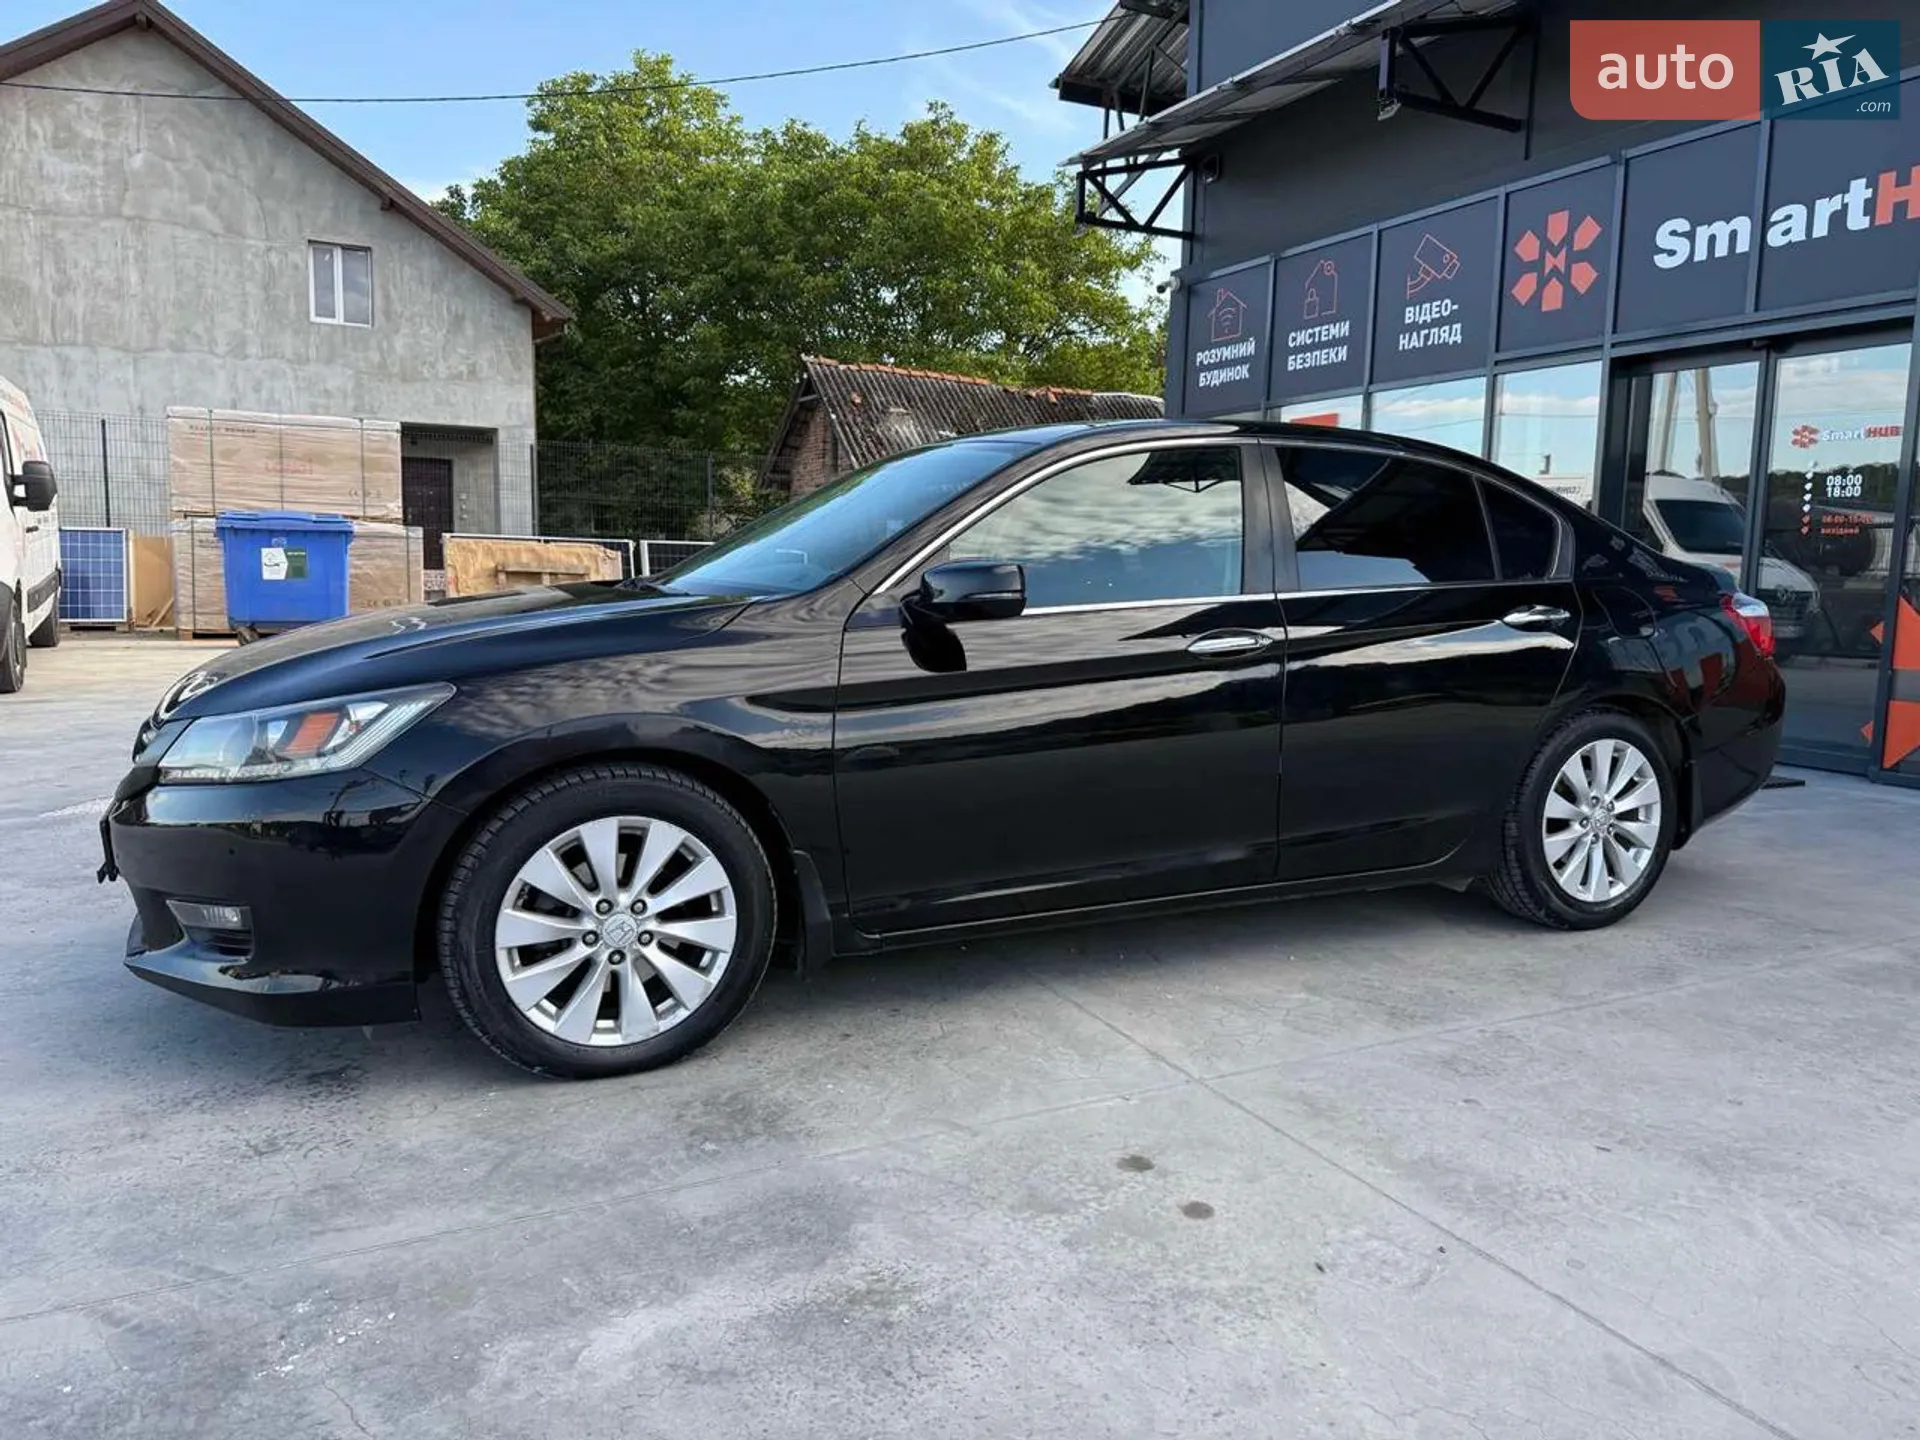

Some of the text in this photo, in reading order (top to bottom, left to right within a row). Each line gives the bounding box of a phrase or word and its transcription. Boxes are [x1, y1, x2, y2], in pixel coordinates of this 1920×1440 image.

[1404, 298, 1459, 325] ВІДЕО-
[1288, 320, 1350, 348] СИСТЕМИ
[1398, 323, 1462, 351] НАГЛЯД
[1196, 336, 1256, 367] РОЗУМНИЙ
[1287, 345, 1348, 371] БЕЗПЕКИ
[1198, 363, 1251, 387] БУДИНОК
[1826, 474, 1863, 486] 08:00
[1826, 486, 1862, 498] 18:00
